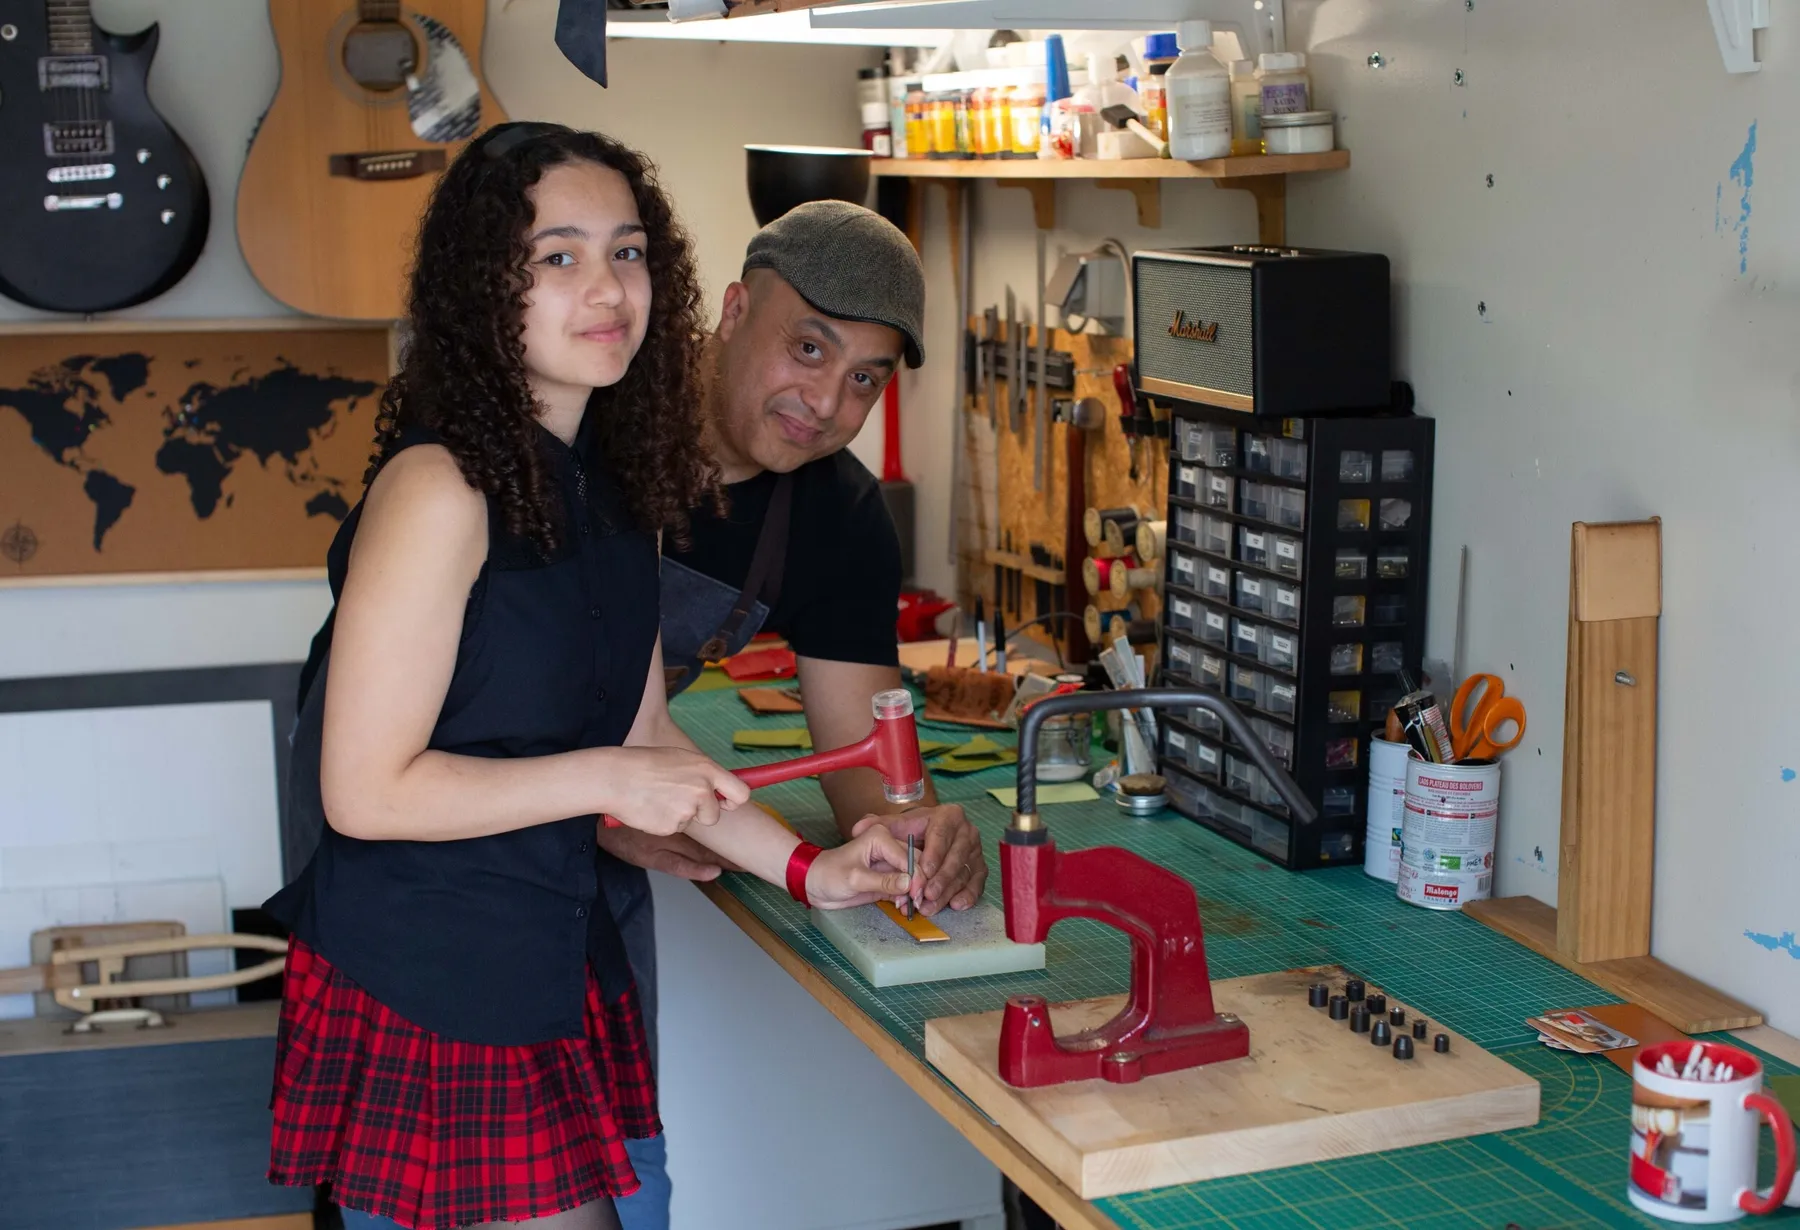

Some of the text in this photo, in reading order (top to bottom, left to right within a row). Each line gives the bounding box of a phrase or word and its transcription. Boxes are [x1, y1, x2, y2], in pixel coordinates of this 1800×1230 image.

[1168, 310, 1219, 342] Marshall
[1429, 778, 1449, 789] PLATEAU
[1450, 781, 1459, 790] DES
[1426, 885, 1457, 898] Malongo
